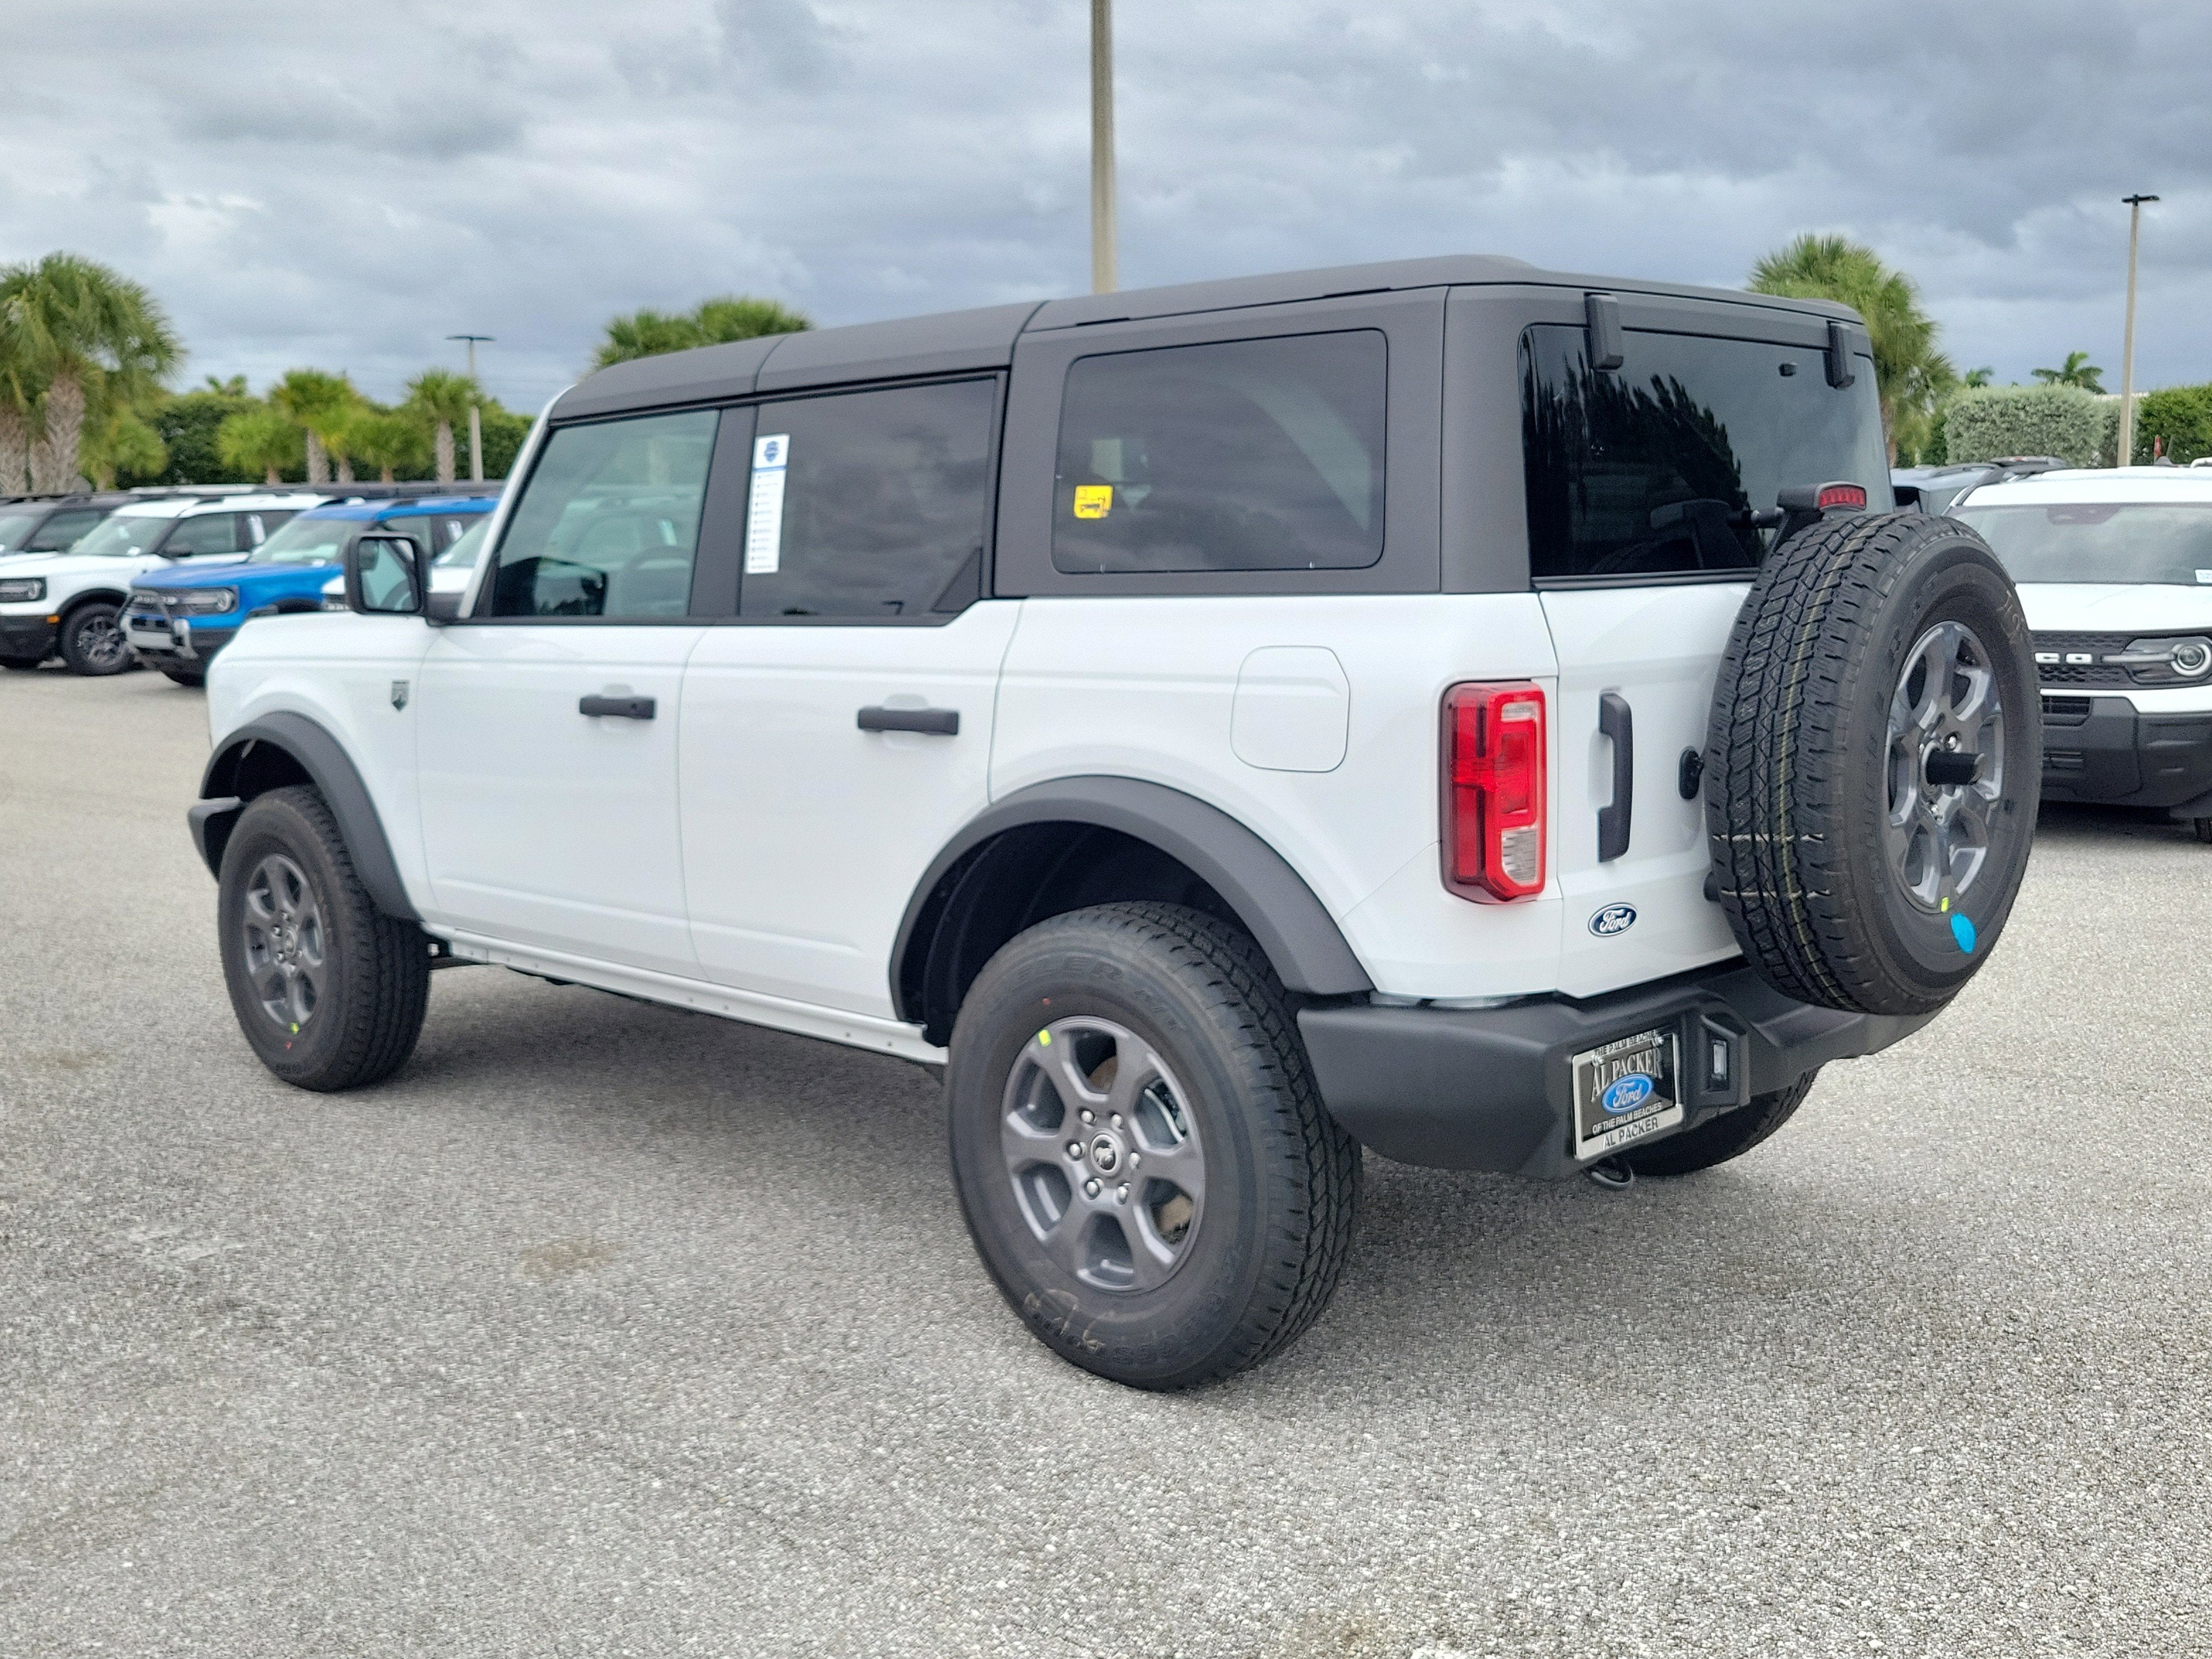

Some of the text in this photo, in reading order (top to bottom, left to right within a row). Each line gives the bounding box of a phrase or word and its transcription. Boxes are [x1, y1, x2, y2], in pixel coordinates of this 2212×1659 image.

[1599, 909, 1632, 932] Ford
[1594, 1045, 1607, 1056] THE
[1609, 1040, 1627, 1052] PALM
[1591, 1047, 1662, 1102] AL PACKER
[1613, 1081, 1643, 1108] Ford
[1592, 1102, 1662, 1135] OF THE PALM BEACHES
[1602, 1116, 1658, 1150] AL PACKER
